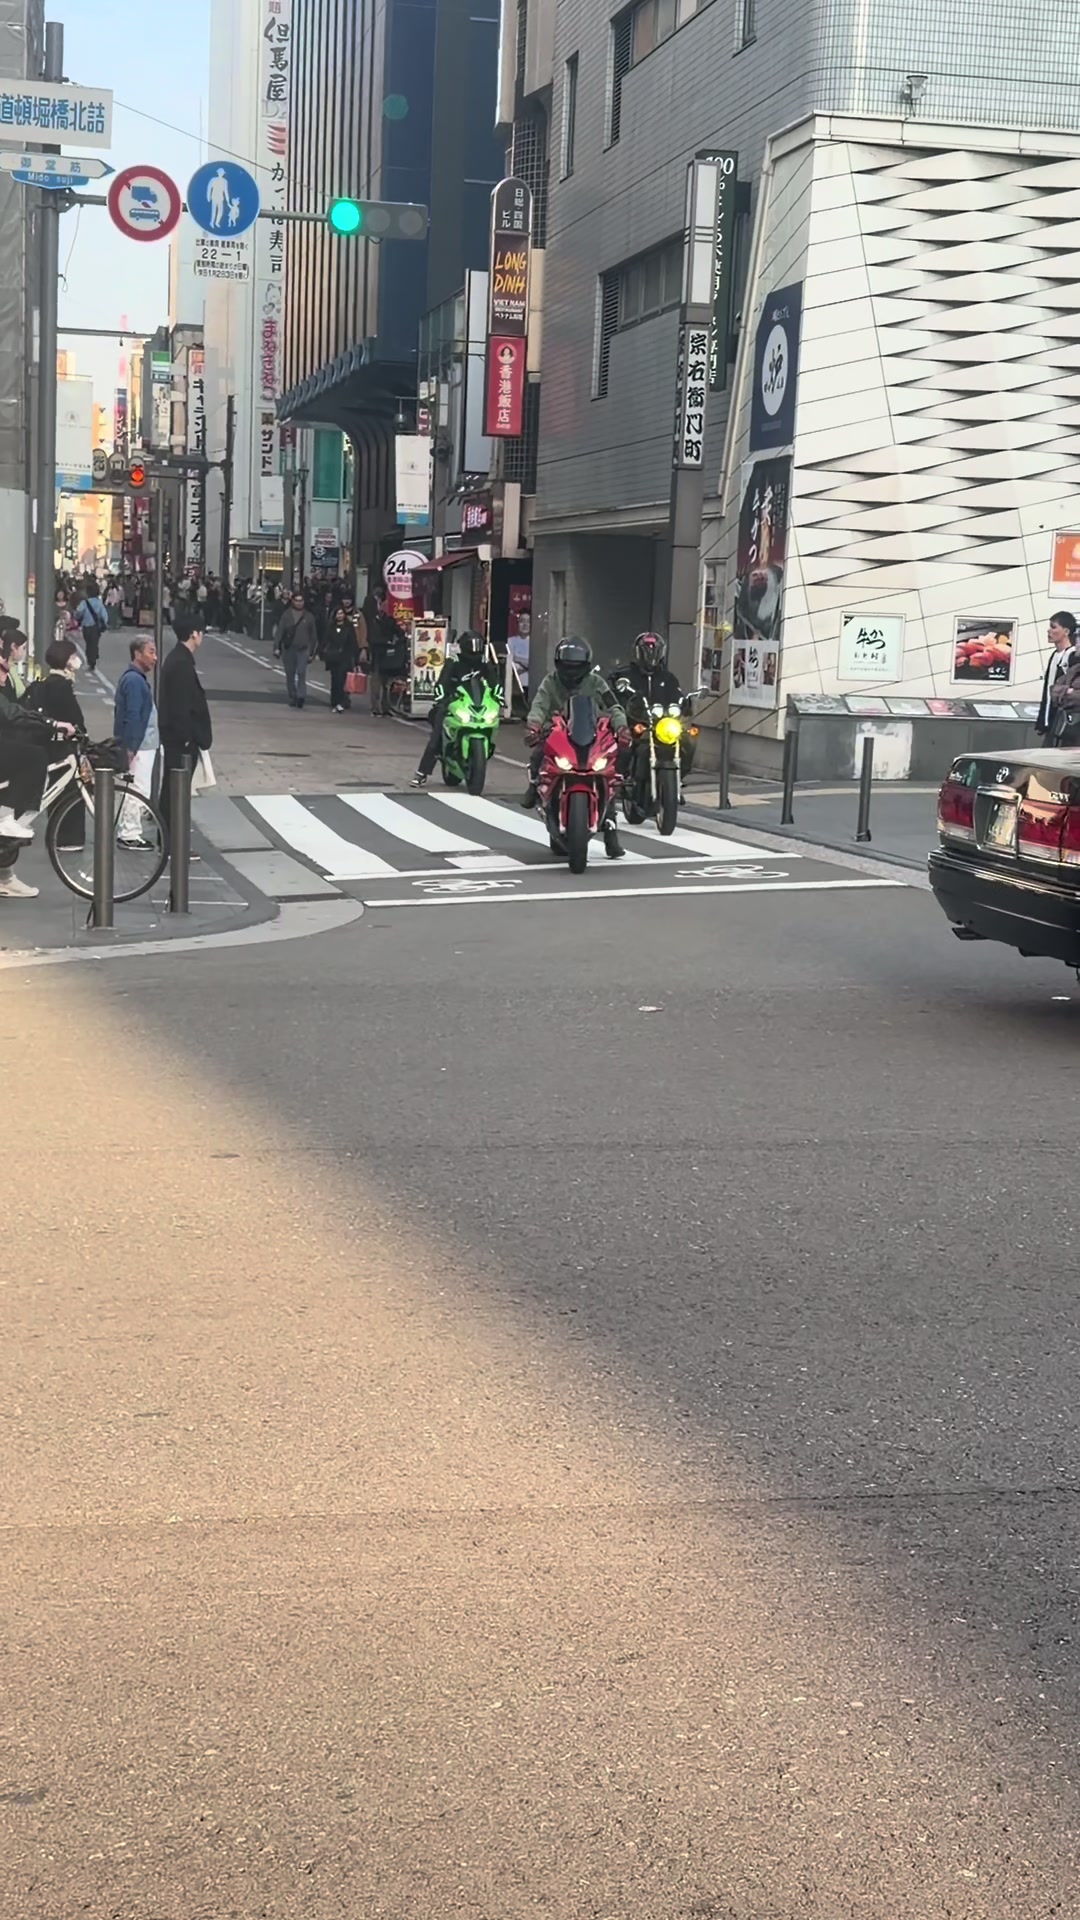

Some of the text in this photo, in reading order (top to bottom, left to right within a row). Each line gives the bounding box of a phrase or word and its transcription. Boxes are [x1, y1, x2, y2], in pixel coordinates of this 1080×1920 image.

[264, 17, 289, 101] 但馬屋
[0, 93, 105, 134] 道頓堀橋北詰
[495, 251, 527, 274] LONG
[494, 274, 526, 294] DINH
[497, 364, 513, 423] 香港飯店
[684, 332, 707, 461] 宗右衛門町
[856, 627, 886, 650] 牛かつ
